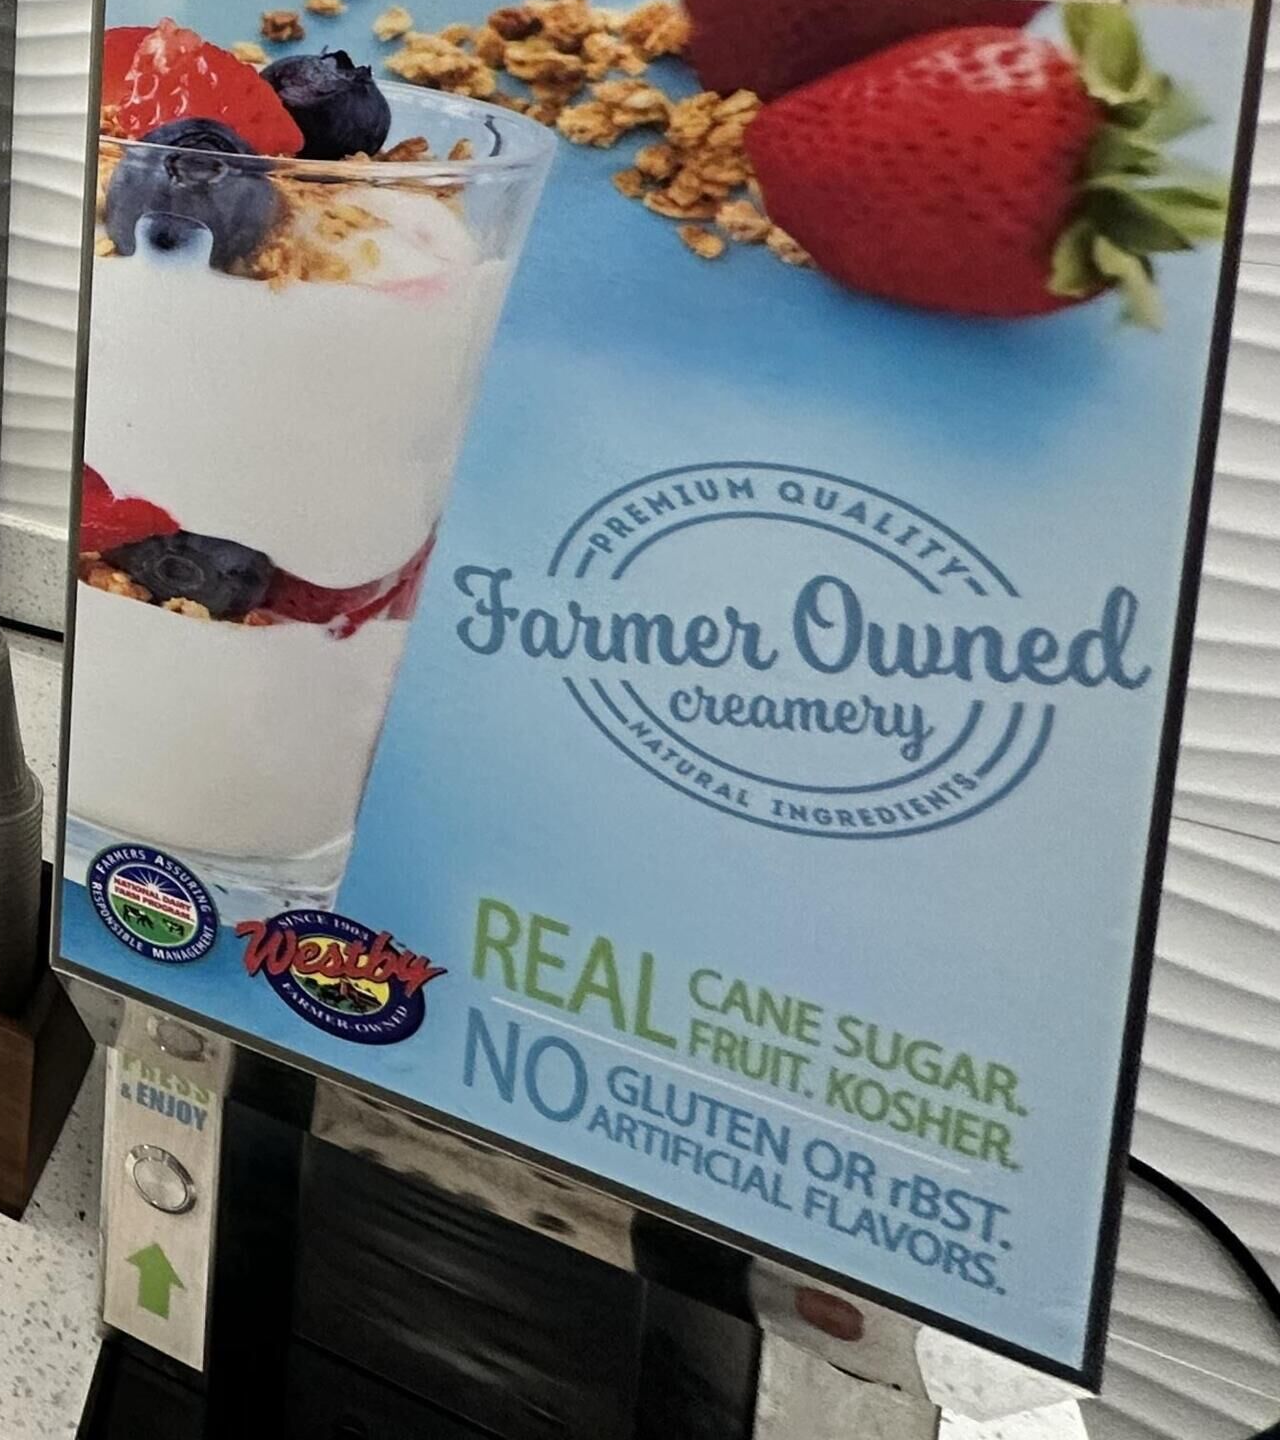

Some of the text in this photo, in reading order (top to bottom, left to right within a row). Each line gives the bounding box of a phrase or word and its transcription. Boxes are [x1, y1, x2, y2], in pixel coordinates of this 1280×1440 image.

[590, 477, 965, 580] PREMIUM QUALITY
[453, 565, 1152, 689] Farmer Owned
[668, 685, 934, 759] creamery
[628, 720, 978, 828] NATURAL INGREDIENTS
[92, 881, 215, 961] RESPONSIBLE MANAGEMENT
[95, 848, 212, 913] FARMERS ASSURING
[277, 913, 329, 930] SINCE
[235, 919, 448, 999] Westby
[281, 982, 408, 1033] FARMER-OWNED
[472, 897, 1028, 1117] REAL CANE SUGAR.
[136, 1081, 208, 1131] ENJOY
[462, 1006, 1013, 1250] NO GLUTEN OR rBST.
[689, 1017, 1023, 1173] FRUIT. KOSHER.
[586, 1105, 1007, 1296] ARTIFICIAL FLAVORS.
